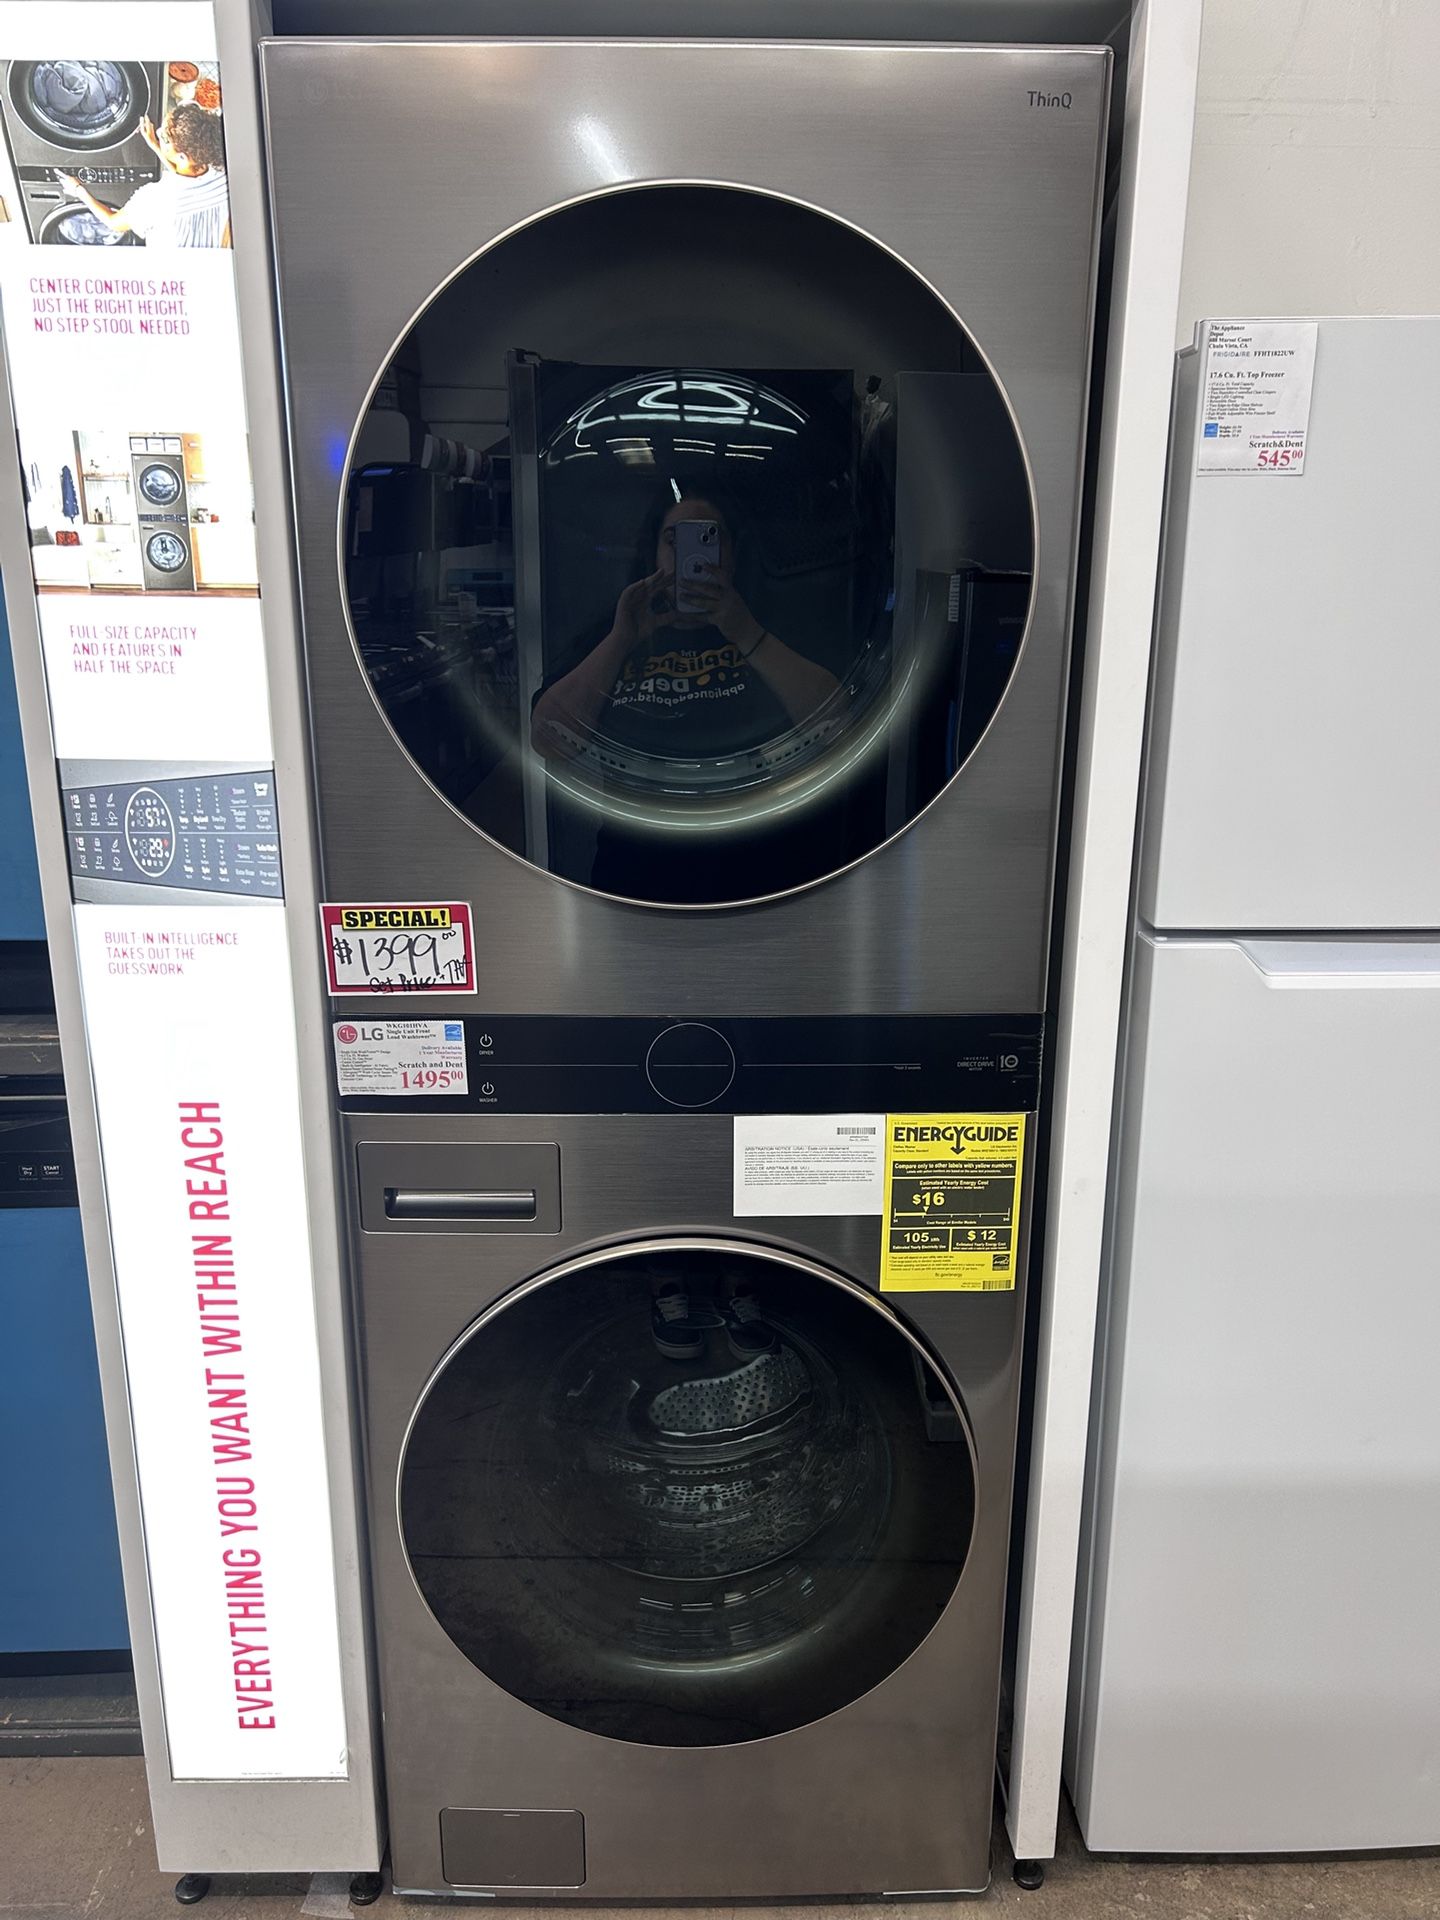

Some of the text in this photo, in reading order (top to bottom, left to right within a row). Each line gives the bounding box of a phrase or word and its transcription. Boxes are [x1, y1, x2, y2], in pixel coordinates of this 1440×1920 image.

[1027, 91, 1072, 110] ThinQ
[30, 278, 187, 296] CENTER CONTROLS ARE
[33, 298, 61, 313] JUST
[67, 298, 91, 314] THE
[95, 299, 133, 315] RIGHT
[35, 317, 190, 335] NO STEP STOOL NEEDED
[1247, 372, 1259, 380] Top
[1249, 440, 1304, 448] Scratch&Dent
[1257, 449, 1291, 467] 545
[134, 626, 197, 641] CAPACITY
[73, 642, 182, 657] AND FEATURES IN
[74, 660, 177, 675] HALF THE SPACE
[344, 910, 448, 928] SPECIAL!
[158, 932, 239, 945] INTELLIGENCE
[106, 946, 196, 960] TAKES OUT THE
[333, 933, 441, 976] $1399
[108, 962, 185, 975] GUESSWORK
[361, 1027, 384, 1041] LG
[957, 1060, 995, 1068] DIRECT DRIVE
[400, 1070, 451, 1089] 1495
[894, 1126, 1020, 1144] ENERGYGUIDE
[179, 1103, 229, 1219] REACH
[895, 1163, 917, 1172] Compare
[918, 1163, 929, 1172] only
[935, 1162, 948, 1170] other
[948, 1162, 963, 1170] labels
[963, 1162, 975, 1170] with
[975, 1162, 991, 1172] yellow
[990, 1162, 1015, 1170] numbers.
[944, 1180, 959, 1188] Yearly
[959, 1179, 978, 1188] Energy
[977, 1179, 990, 1187] Cost
[912, 1191, 946, 1207] $16
[904, 1232, 930, 1243] 105
[980, 1230, 997, 1240] 12
[193, 1236, 241, 1356] WITHIN
[206, 1369, 251, 1463] WANT
[217, 1478, 257, 1536] YOU
[223, 1550, 275, 1728] EVERYTHING
